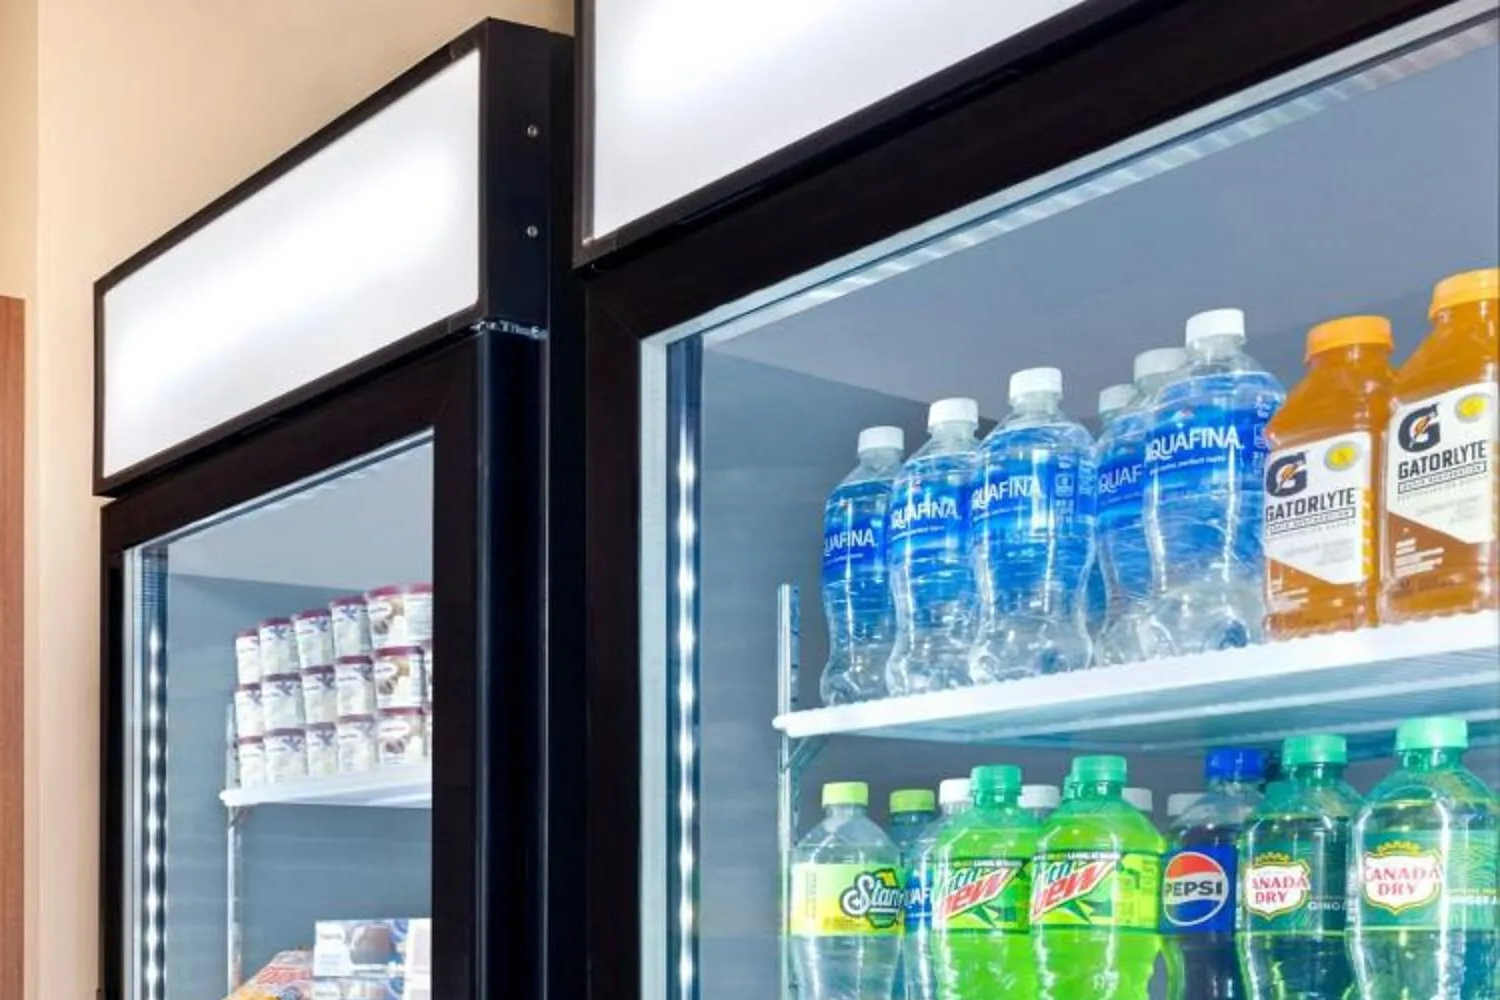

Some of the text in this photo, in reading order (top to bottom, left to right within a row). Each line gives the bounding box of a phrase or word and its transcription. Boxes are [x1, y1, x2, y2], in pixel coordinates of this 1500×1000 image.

[1398, 443, 1488, 480] GATORLYTE
[1266, 487, 1357, 523] GATORLYTE
[1166, 880, 1222, 898] PEPSI
[1251, 873, 1307, 890] ANADA
[1378, 882, 1417, 897] DRY
[1255, 890, 1288, 905] DRY
